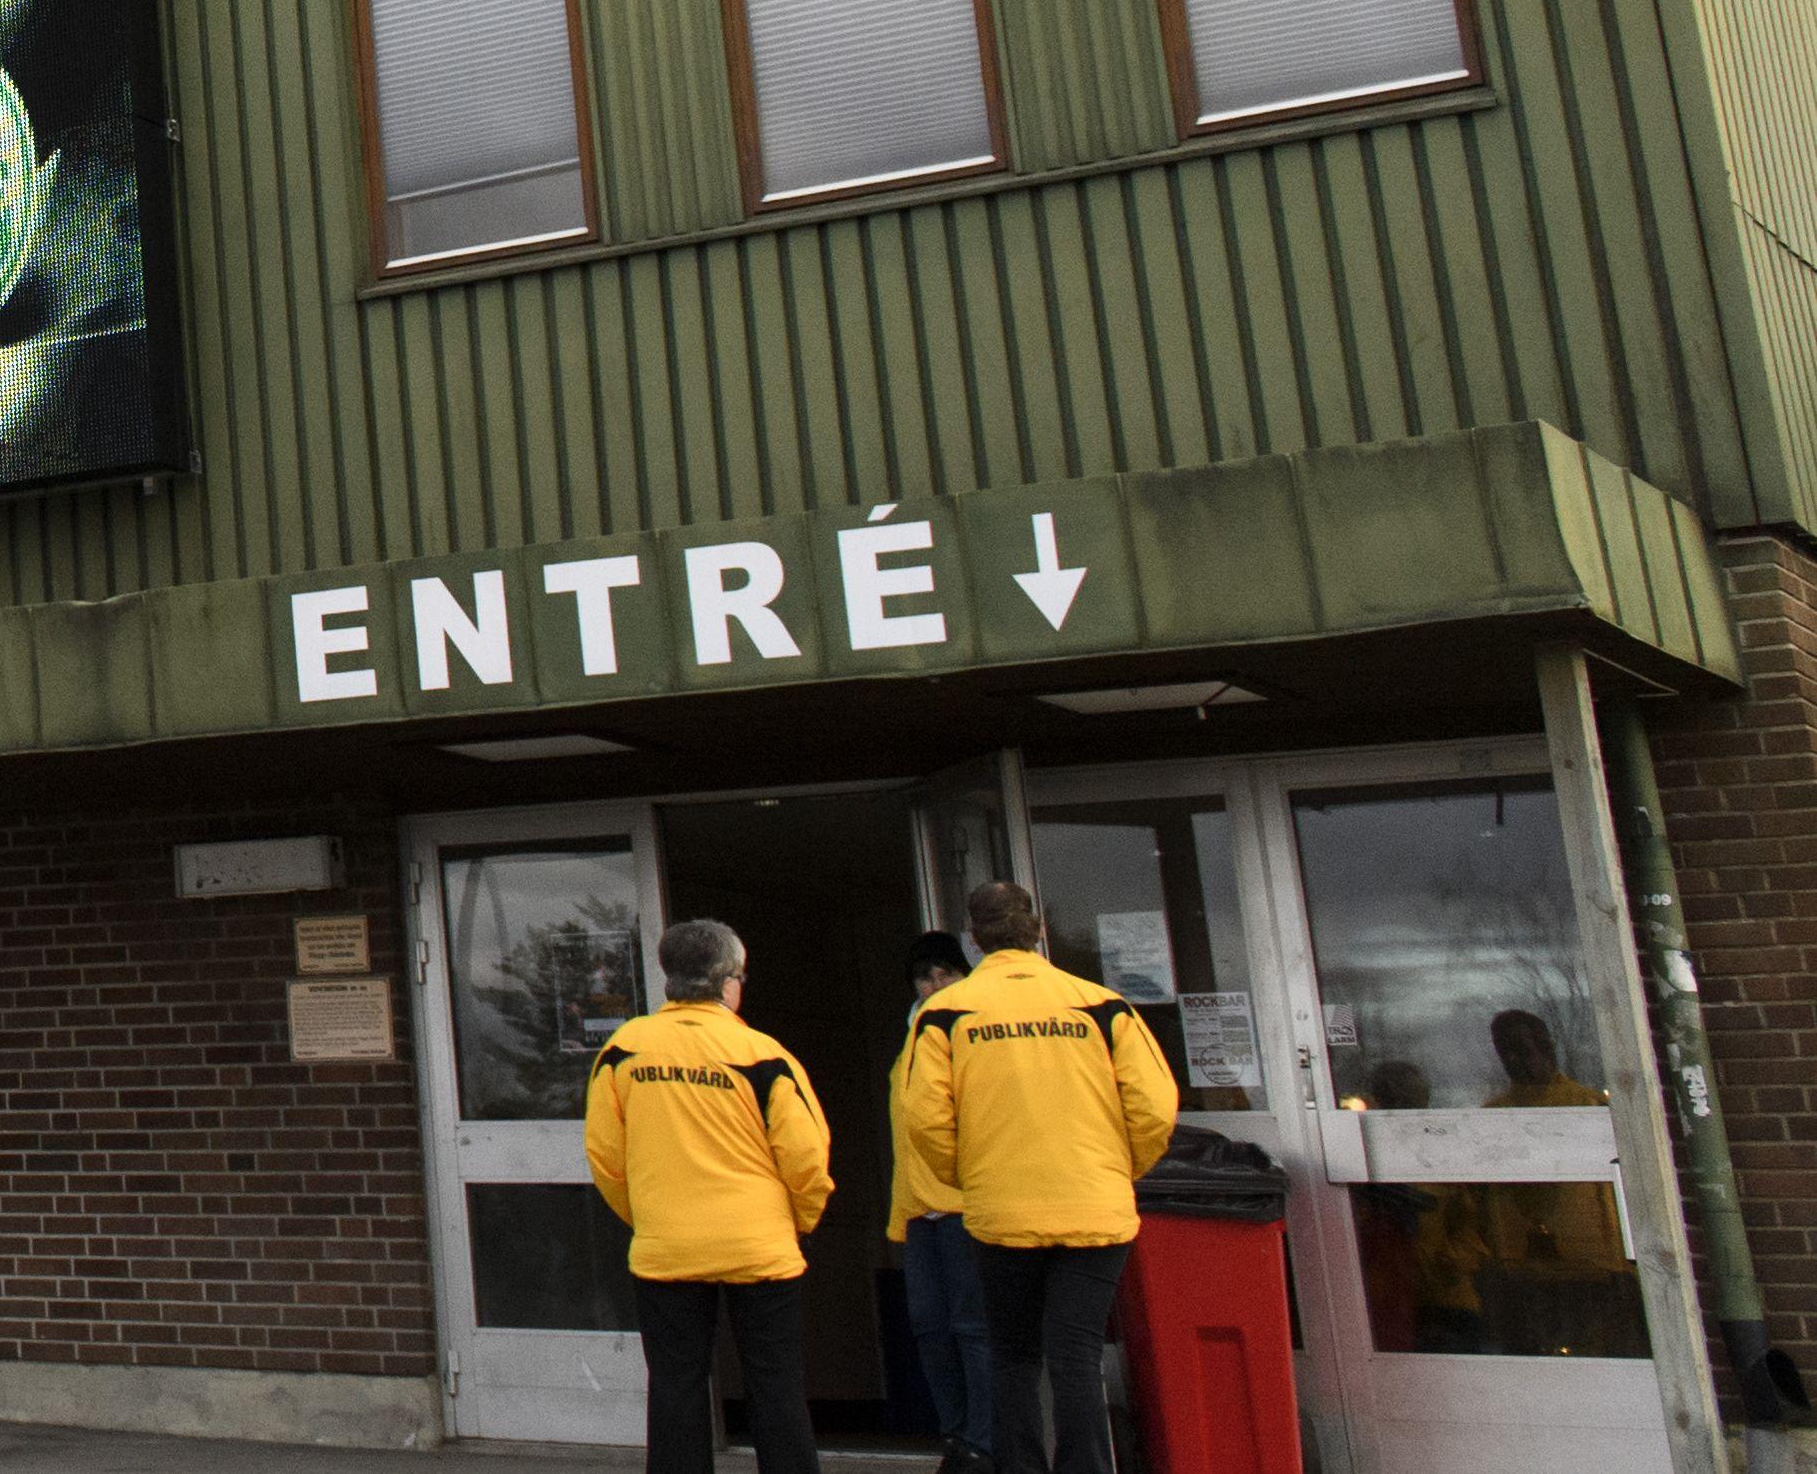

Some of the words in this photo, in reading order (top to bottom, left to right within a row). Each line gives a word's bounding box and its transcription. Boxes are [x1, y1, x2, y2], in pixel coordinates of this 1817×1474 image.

[291, 503, 947, 703] ENTRÉ
[967, 1016, 1089, 1044] PUBLIKVÄRD
[629, 1065, 735, 1090] UBLIKVÄRD
